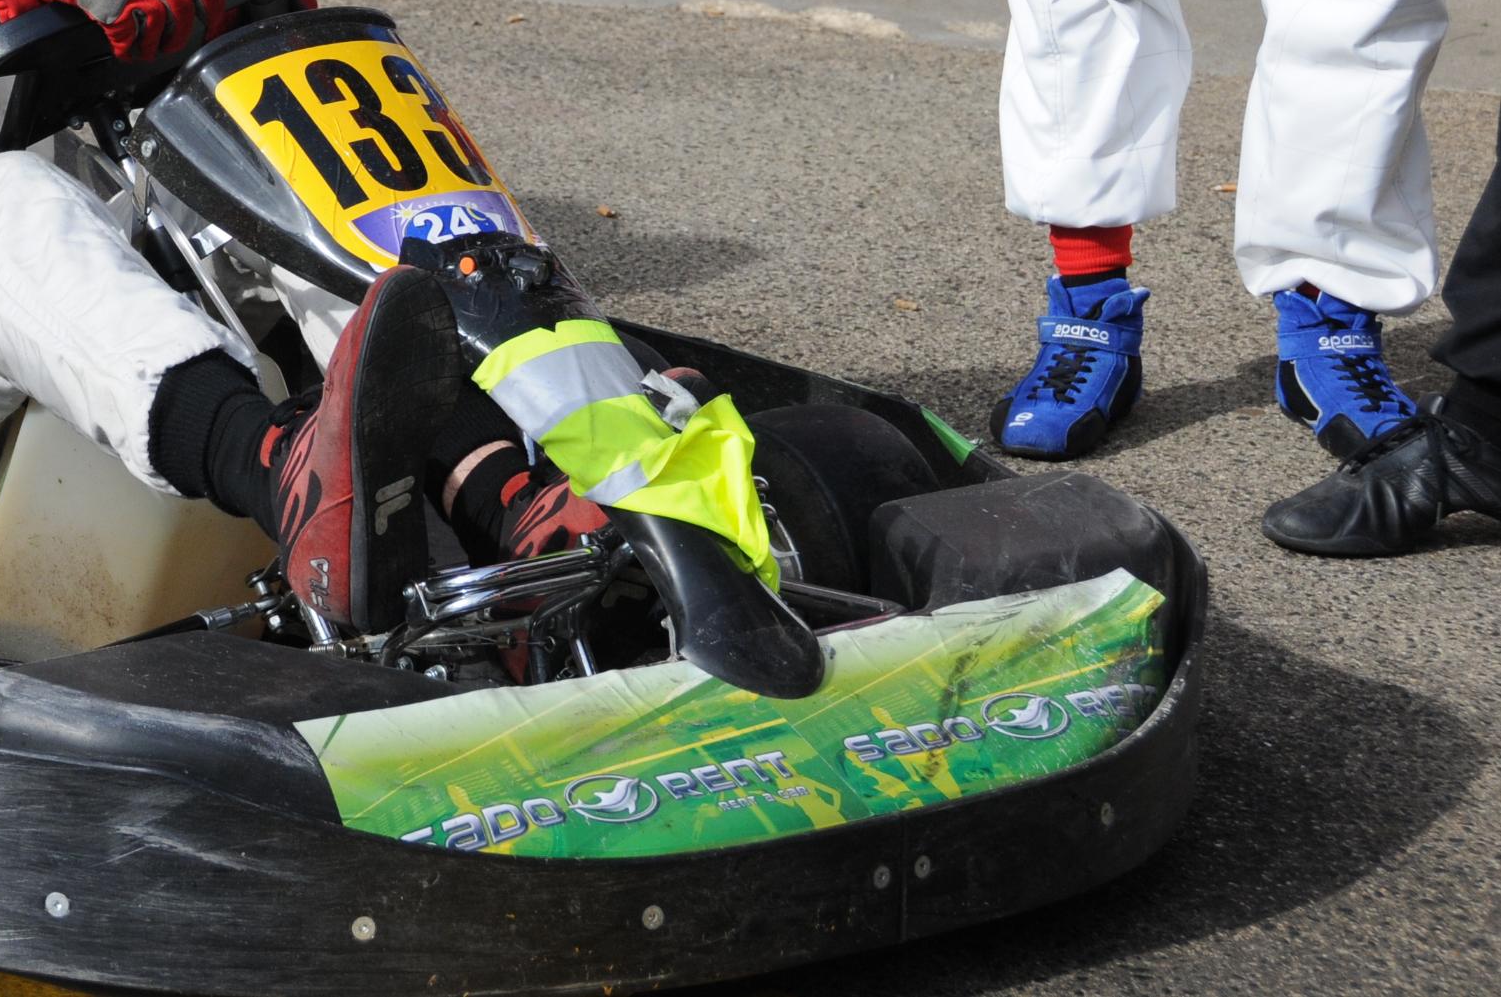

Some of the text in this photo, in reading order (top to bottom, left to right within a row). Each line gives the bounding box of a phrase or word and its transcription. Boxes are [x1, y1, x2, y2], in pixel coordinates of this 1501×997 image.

[250, 54, 493, 210] 133
[412, 206, 481, 245] 24
[1054, 323, 1110, 343] sparco
